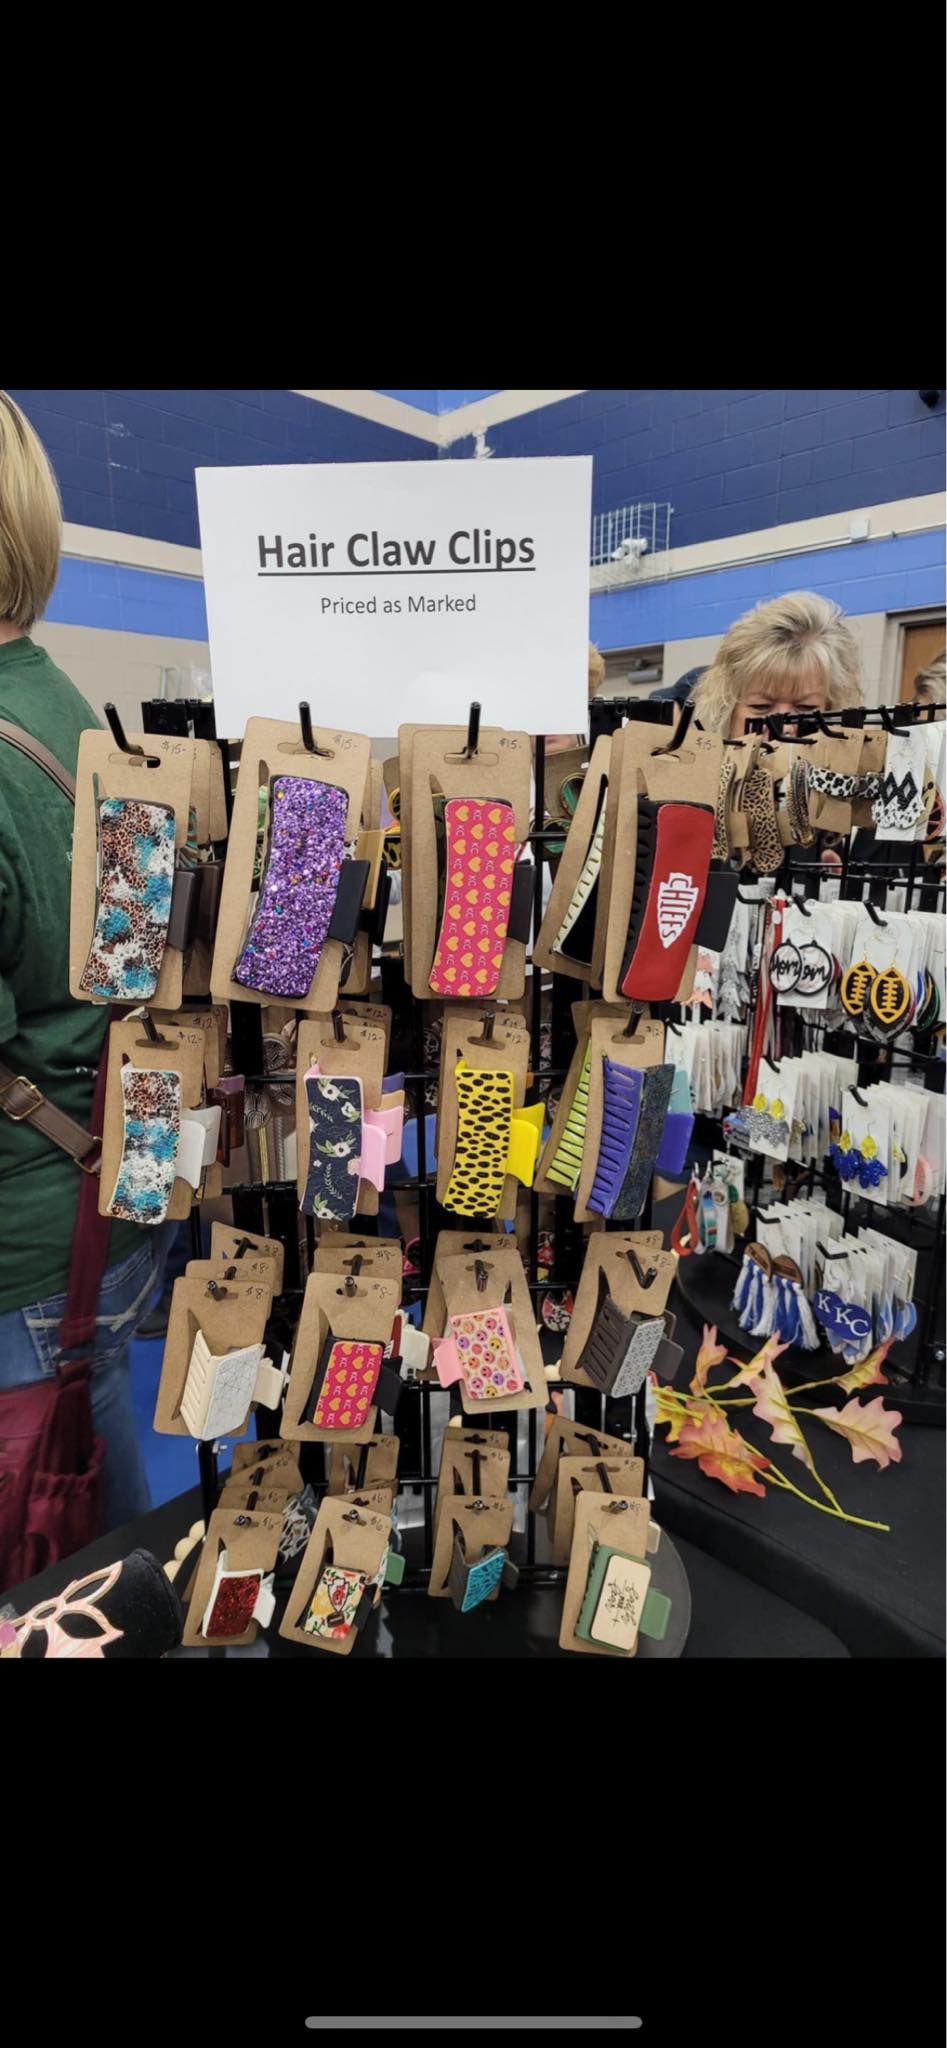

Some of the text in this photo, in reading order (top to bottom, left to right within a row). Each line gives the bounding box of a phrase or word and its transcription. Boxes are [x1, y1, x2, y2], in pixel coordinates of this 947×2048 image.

[258, 528, 536, 571] Hair Claw Clips
[321, 594, 477, 614] Priced as Marked
[660, 878, 694, 938] CHIEFS
[835, 1306, 868, 1337] KC
